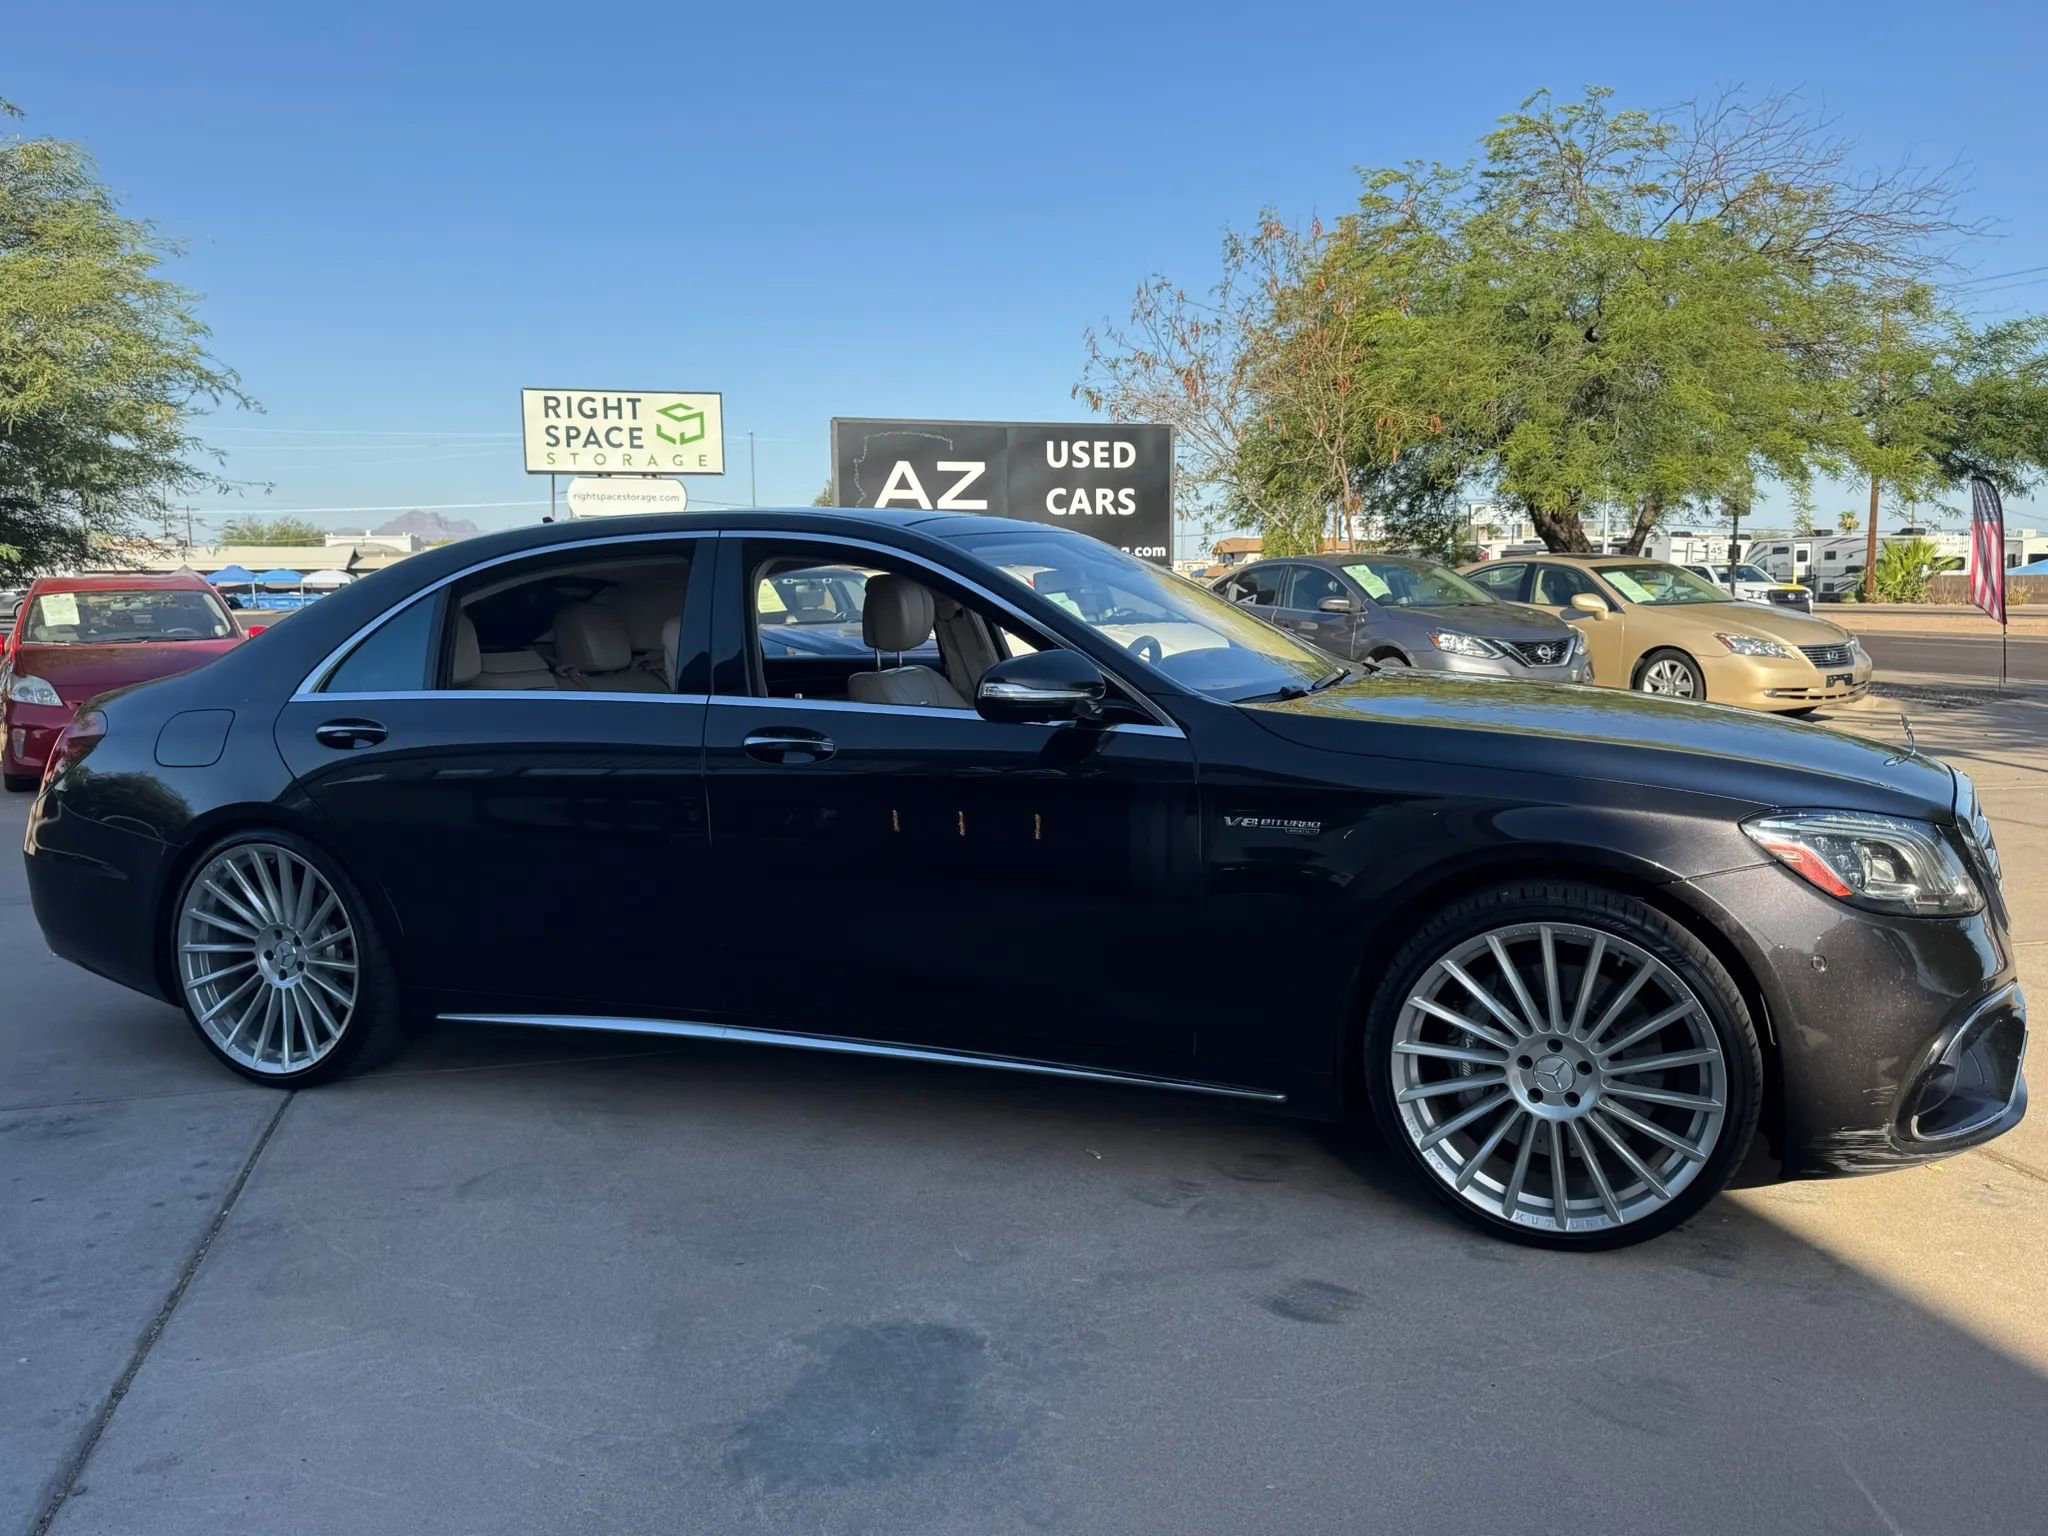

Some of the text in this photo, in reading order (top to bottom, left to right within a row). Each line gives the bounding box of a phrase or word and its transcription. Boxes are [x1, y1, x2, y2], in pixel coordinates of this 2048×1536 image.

[544, 396, 641, 420] RIGHT
[545, 425, 644, 449] SPACE
[547, 452, 707, 467] STORAGE
[1046, 441, 1136, 469] USED
[874, 460, 988, 510] AZ
[573, 493, 680, 503] rightspacestorage.com
[1046, 488, 1136, 515] CARS
[1224, 816, 1321, 828] V8 BITURBO
